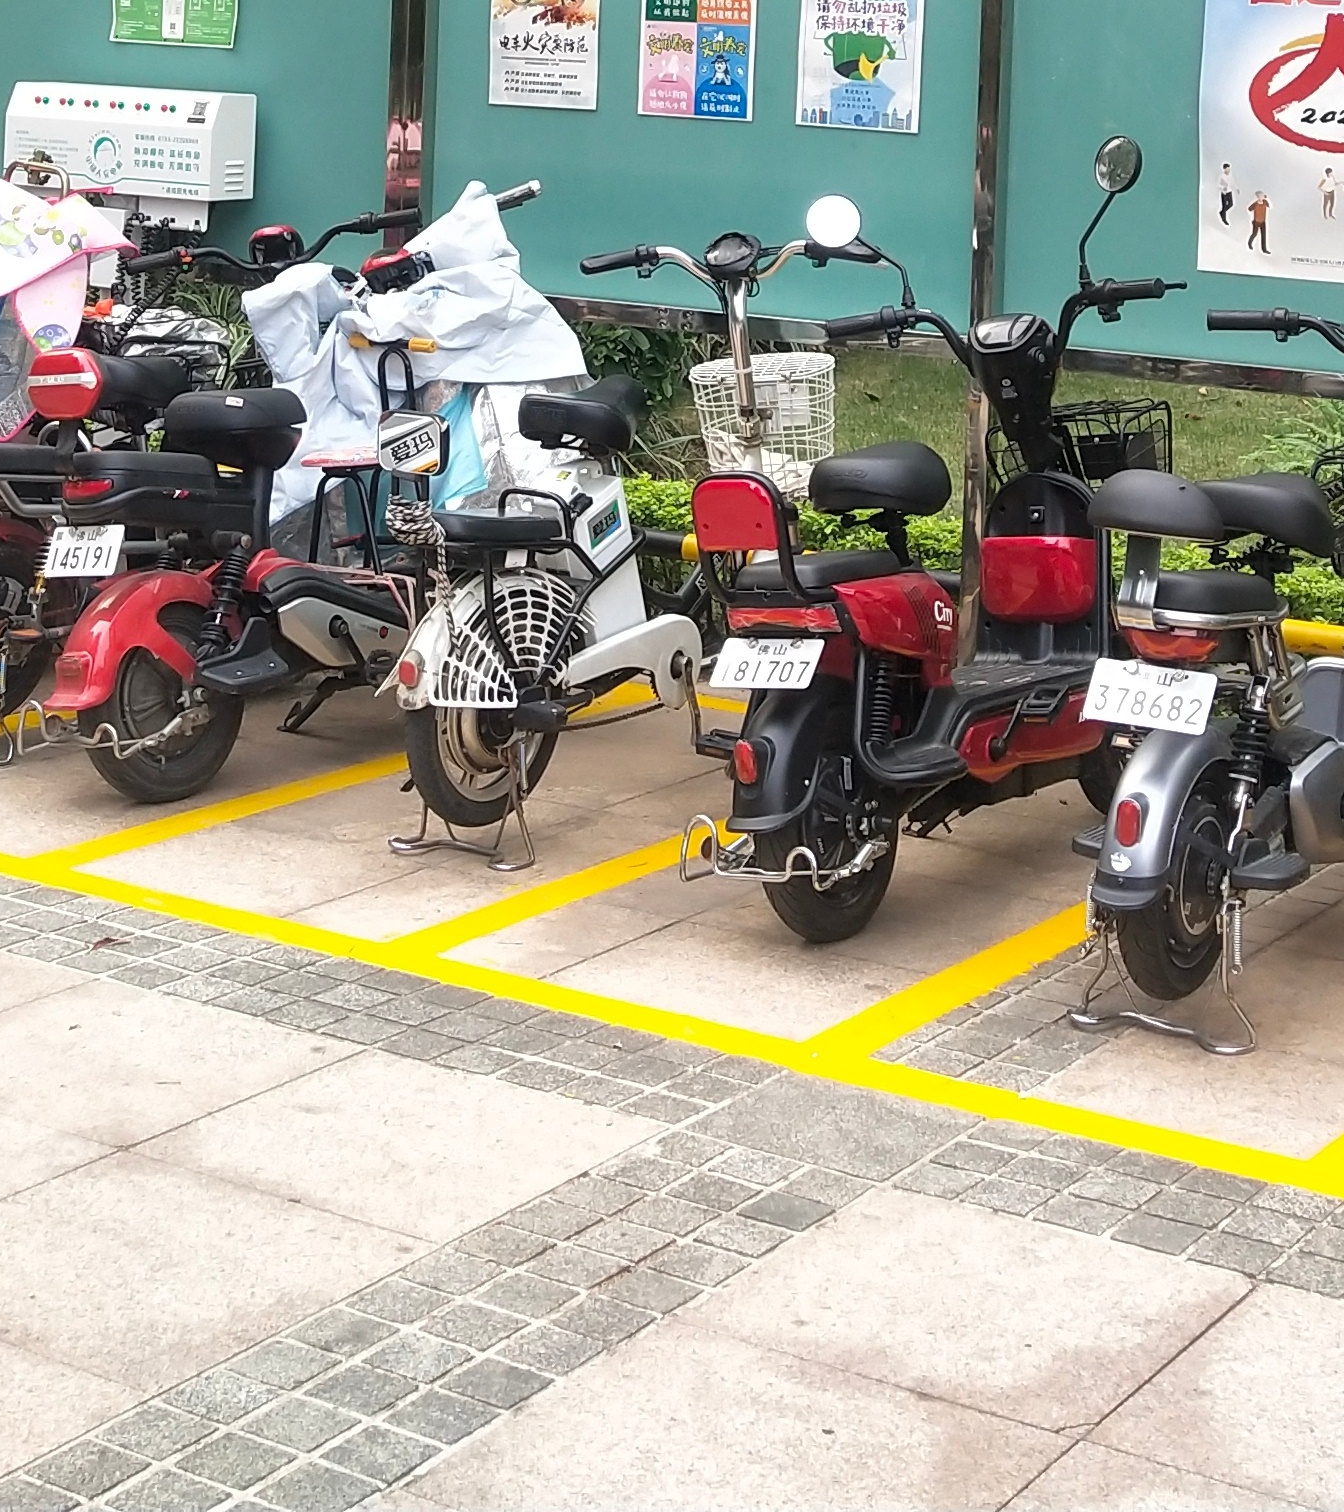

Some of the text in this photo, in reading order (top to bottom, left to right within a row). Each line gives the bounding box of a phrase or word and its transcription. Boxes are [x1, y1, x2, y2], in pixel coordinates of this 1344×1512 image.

[816, 15, 906, 35] 保持环境干净
[389, 430, 435, 466] 爱玛
[51, 545, 113, 570] 145191
[757, 644, 787, 656] 佛山
[721, 660, 810, 682] 181707
[1094, 684, 1203, 726] 378682
